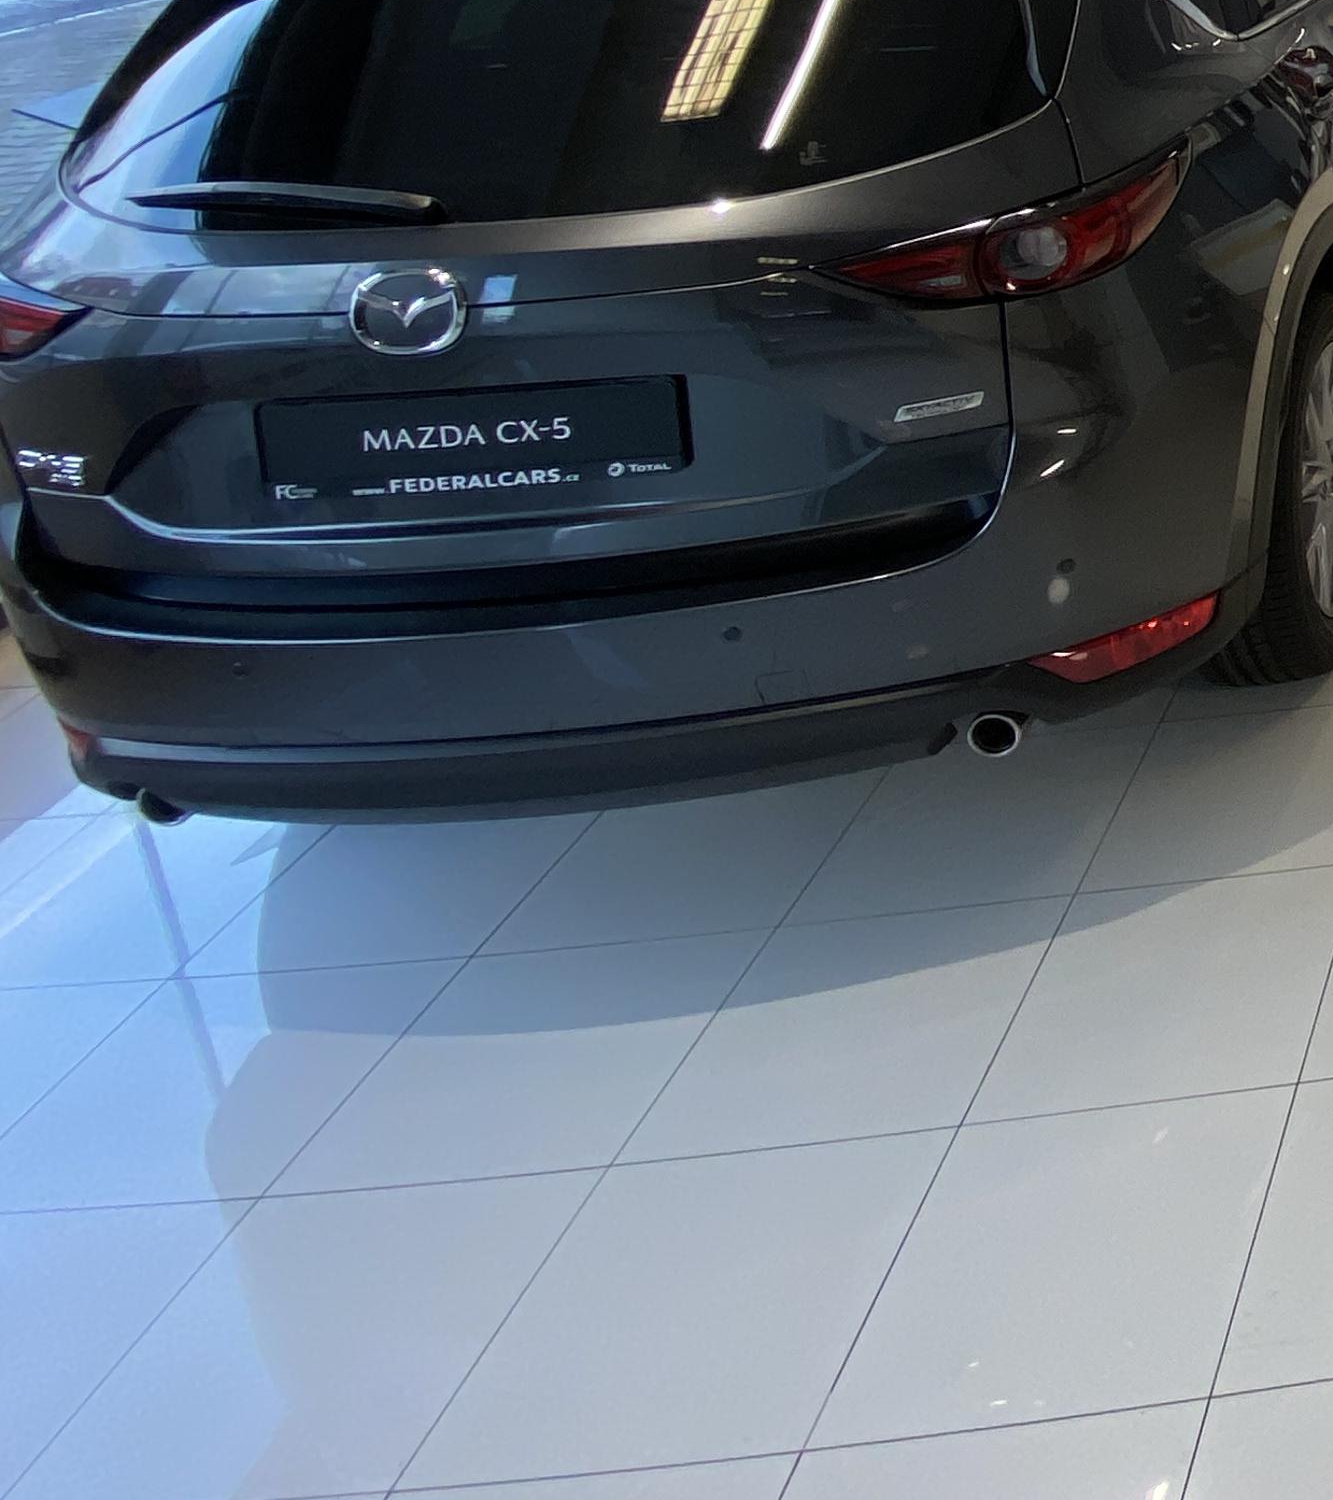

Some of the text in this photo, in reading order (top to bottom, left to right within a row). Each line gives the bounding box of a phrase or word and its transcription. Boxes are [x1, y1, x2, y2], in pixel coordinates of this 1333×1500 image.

[362, 416, 572, 452] MAZDA CX-5
[627, 462, 672, 473] TOTAL
